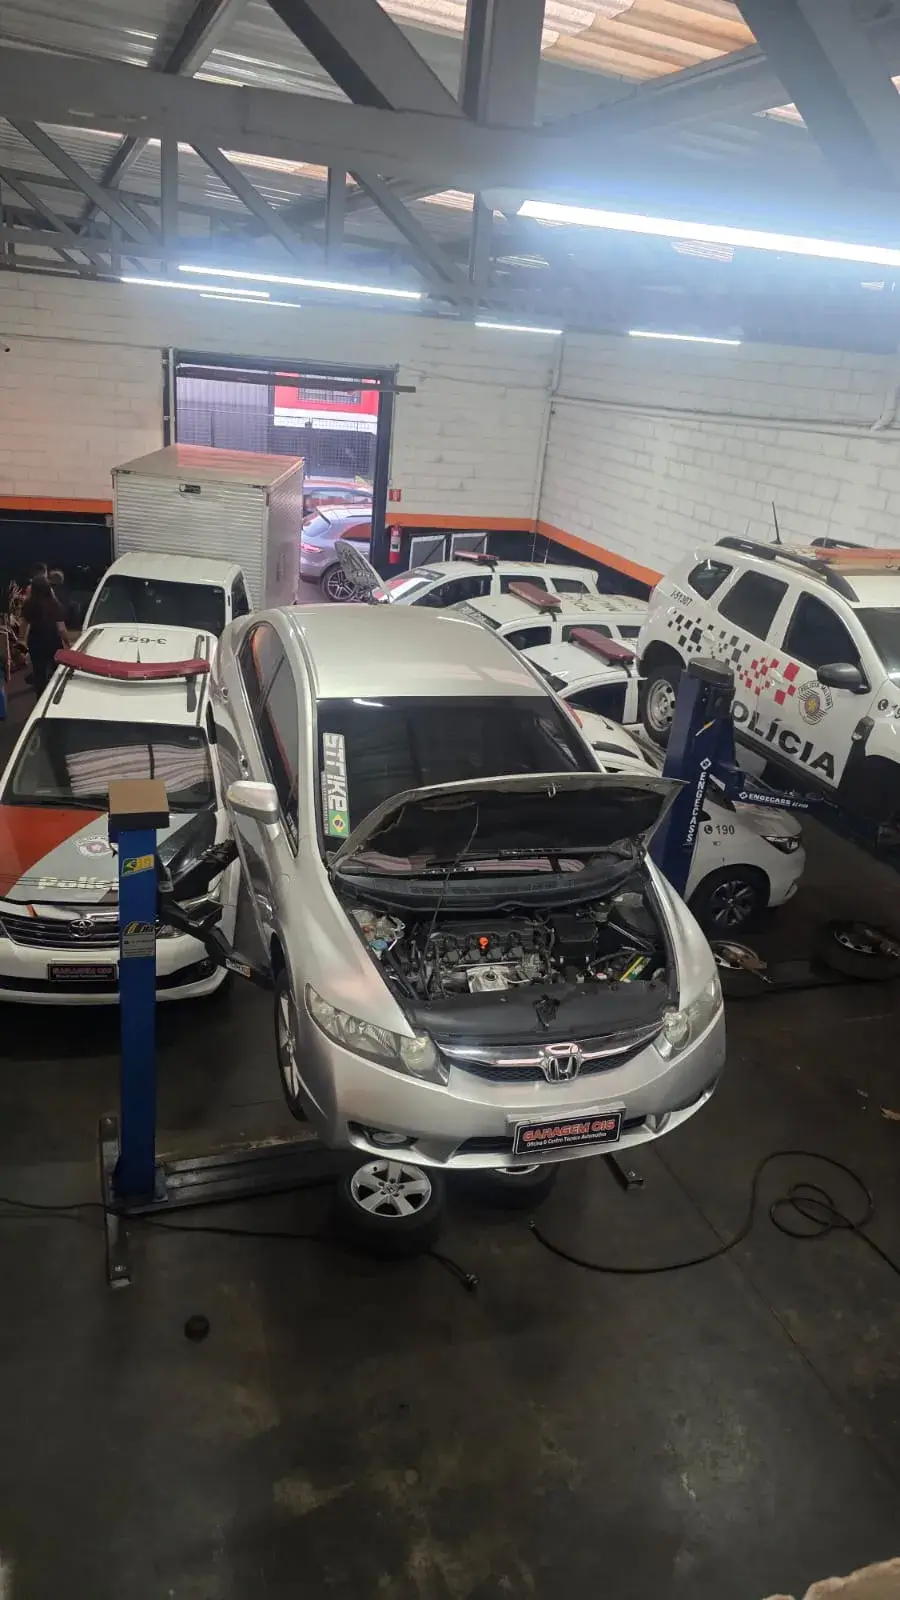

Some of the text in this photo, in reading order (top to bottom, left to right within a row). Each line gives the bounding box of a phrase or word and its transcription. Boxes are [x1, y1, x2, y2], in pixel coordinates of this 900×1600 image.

[730, 700, 834, 780] OLÍCIA
[686, 771, 708, 842] ENGECASS
[715, 824, 735, 835] 190
[522, 1122, 591, 1142] GARAGEM
